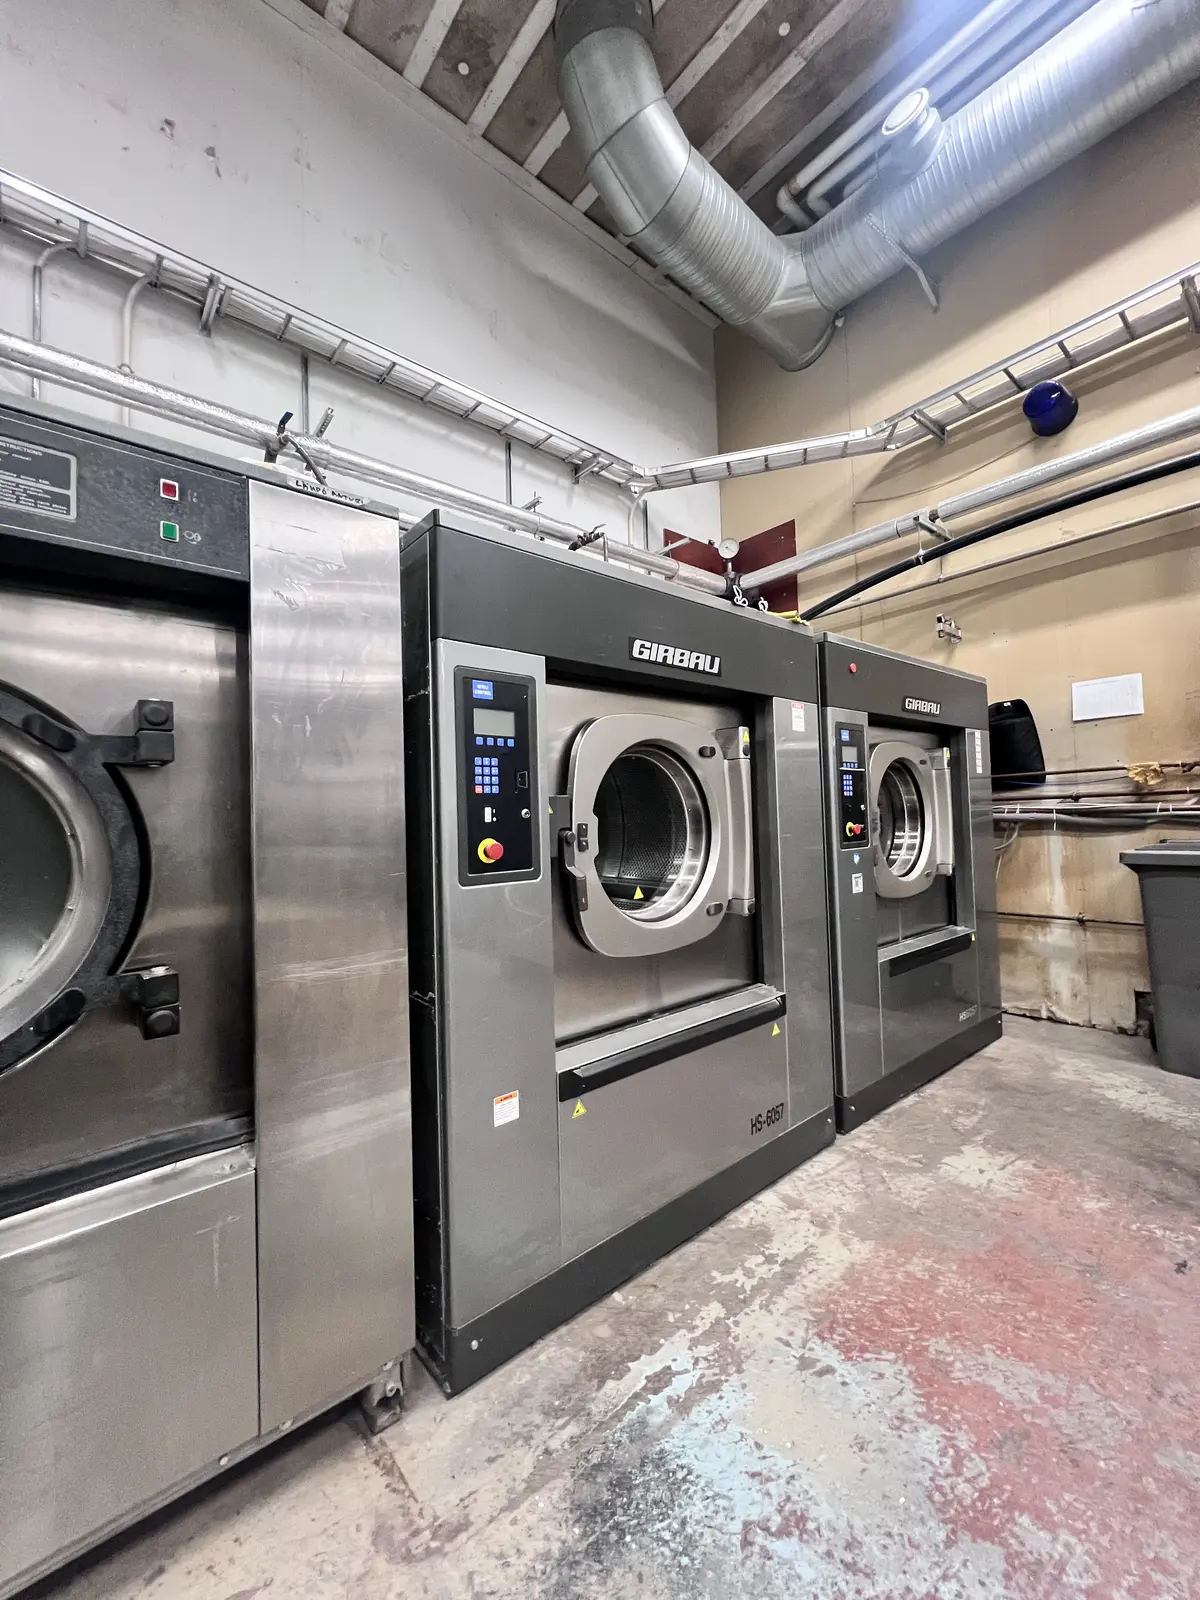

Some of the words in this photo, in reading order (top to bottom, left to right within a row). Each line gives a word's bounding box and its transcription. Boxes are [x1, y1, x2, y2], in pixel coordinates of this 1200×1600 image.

[0, 441, 43, 456] STRUCTIONS
[632, 639, 721, 674] GIRBAU
[905, 697, 941, 715] GIRBAU
[750, 1102, 785, 1136] HS-6057
